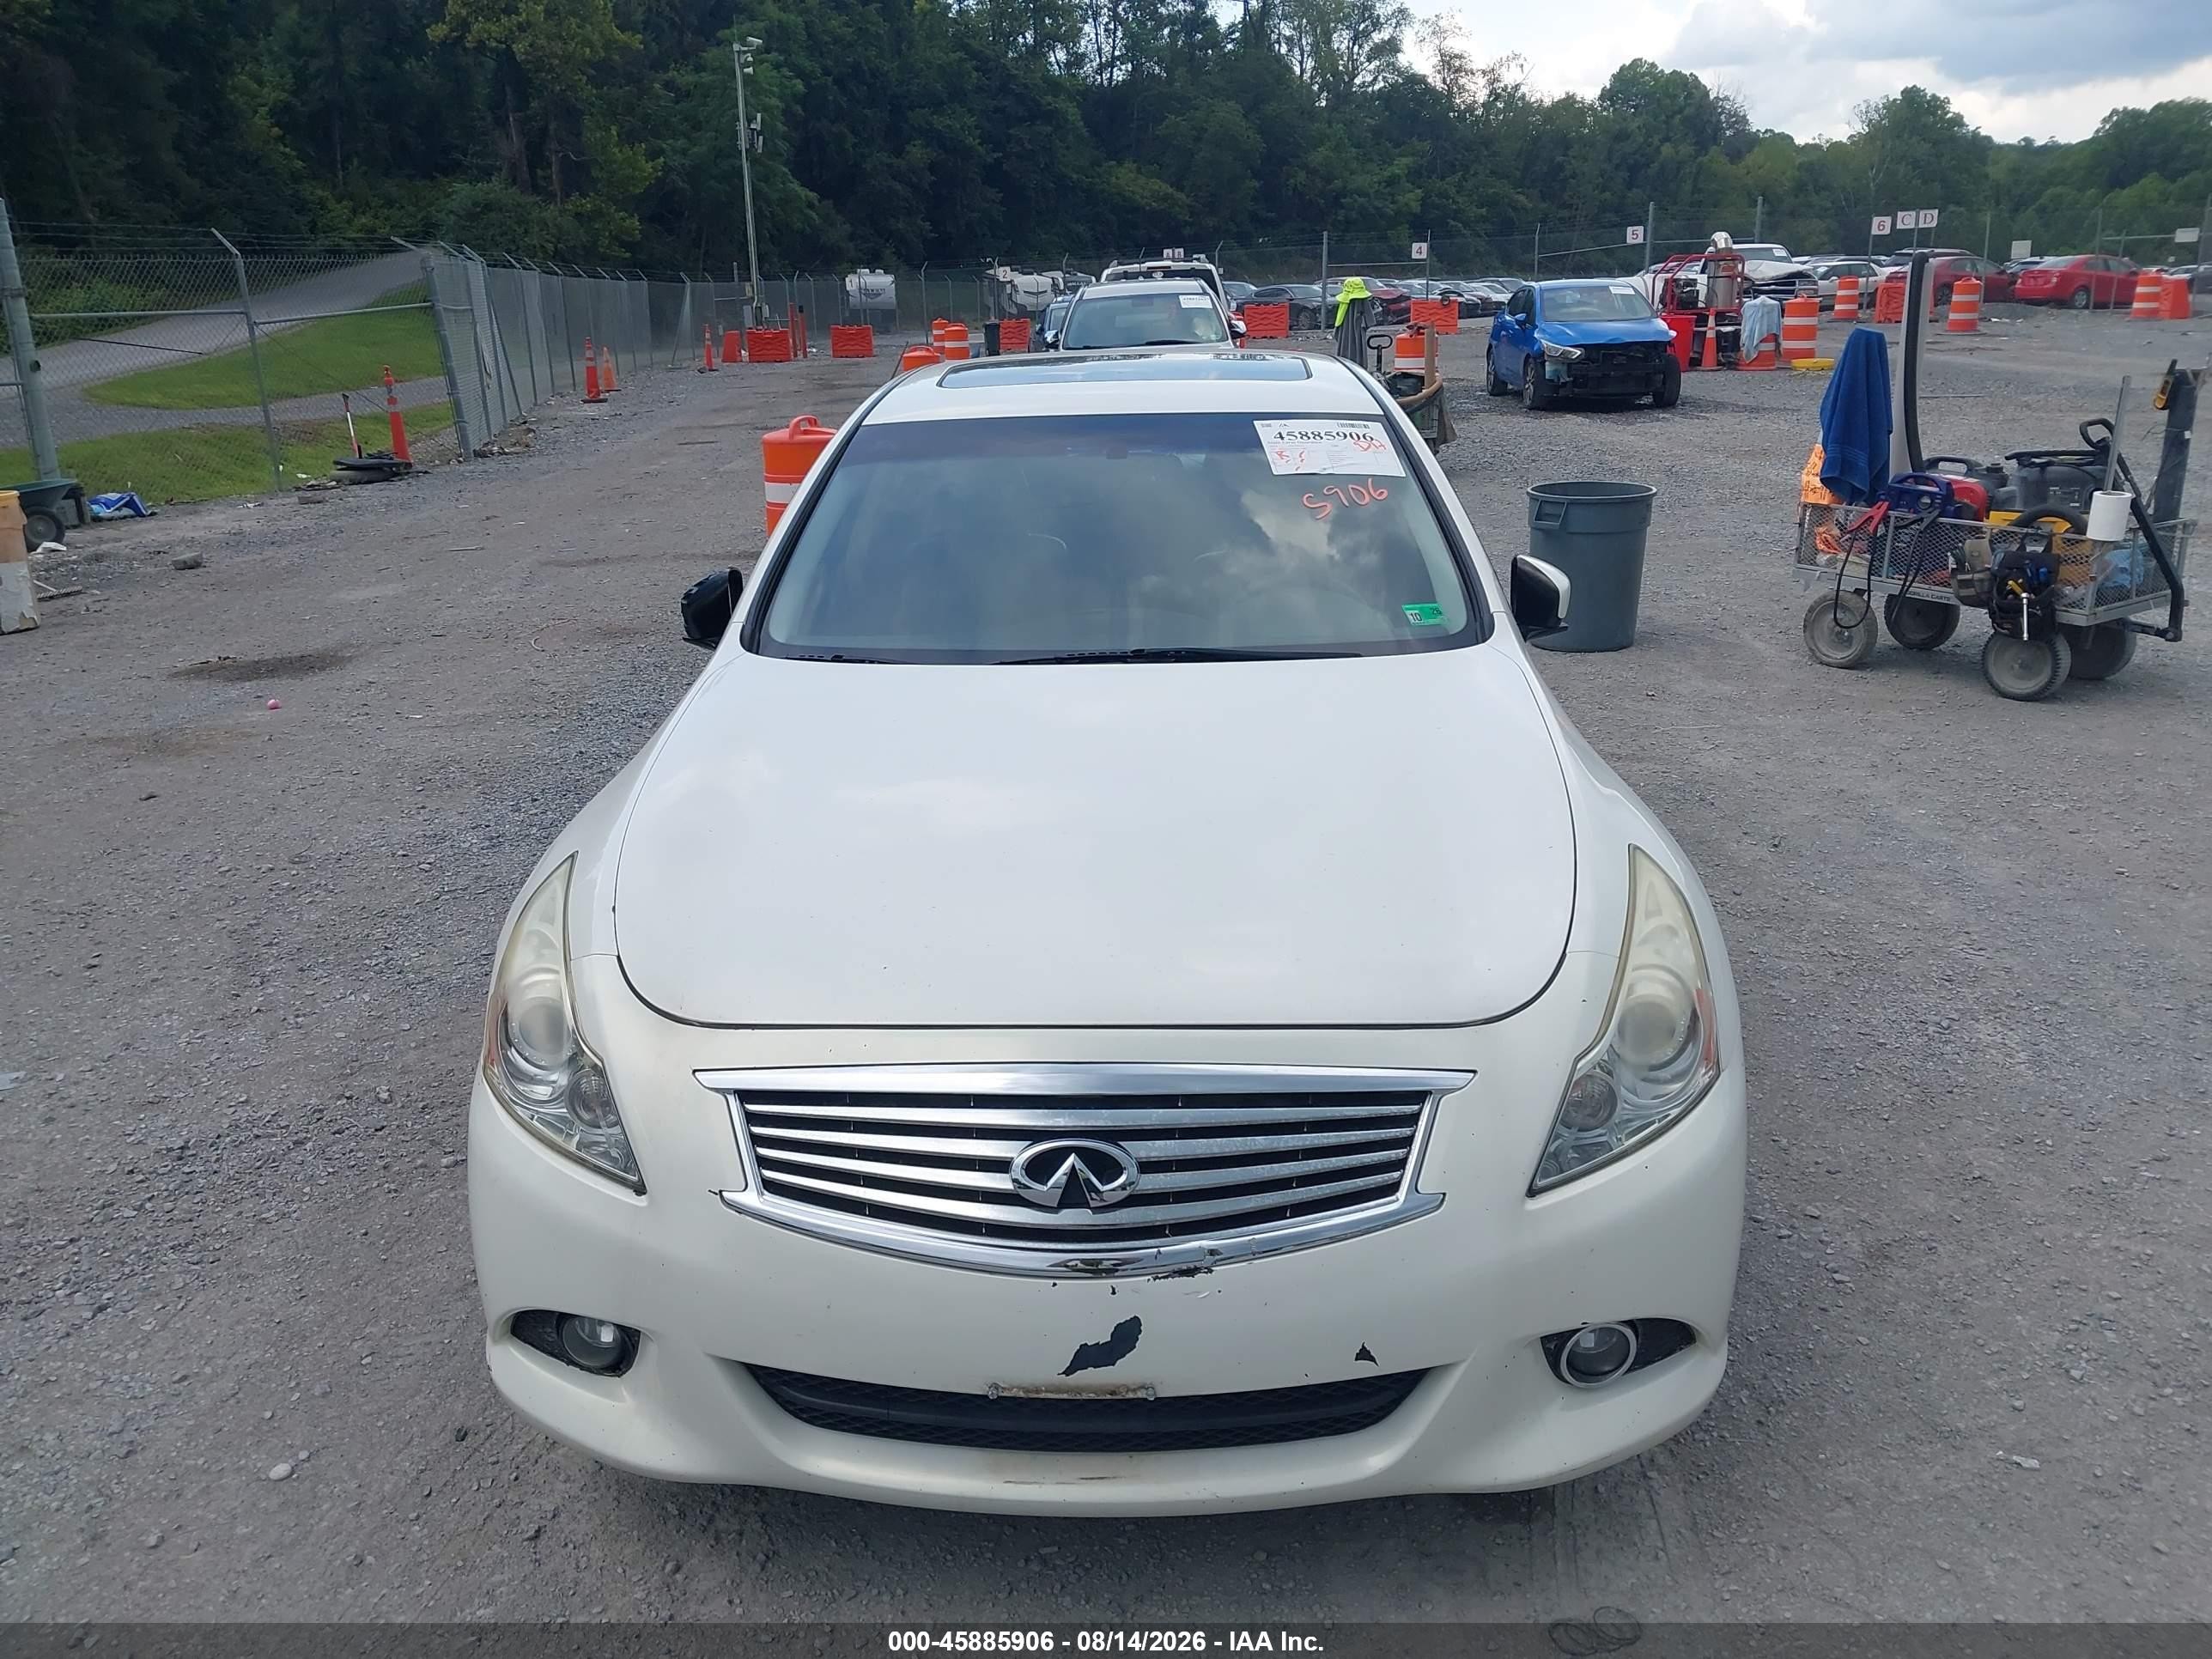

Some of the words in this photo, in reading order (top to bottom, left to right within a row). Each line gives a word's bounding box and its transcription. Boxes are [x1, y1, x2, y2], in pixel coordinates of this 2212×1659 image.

[1901, 213, 1911, 226] C
[1923, 212, 1935, 225] D
[1877, 220, 1886, 232] 6
[1632, 229, 1639, 240] 5
[1416, 246, 1423, 255] 4
[1002, 269, 1008, 279] 2
[1273, 430, 1374, 441] 45885906
[1409, 612, 1423, 622] 10
